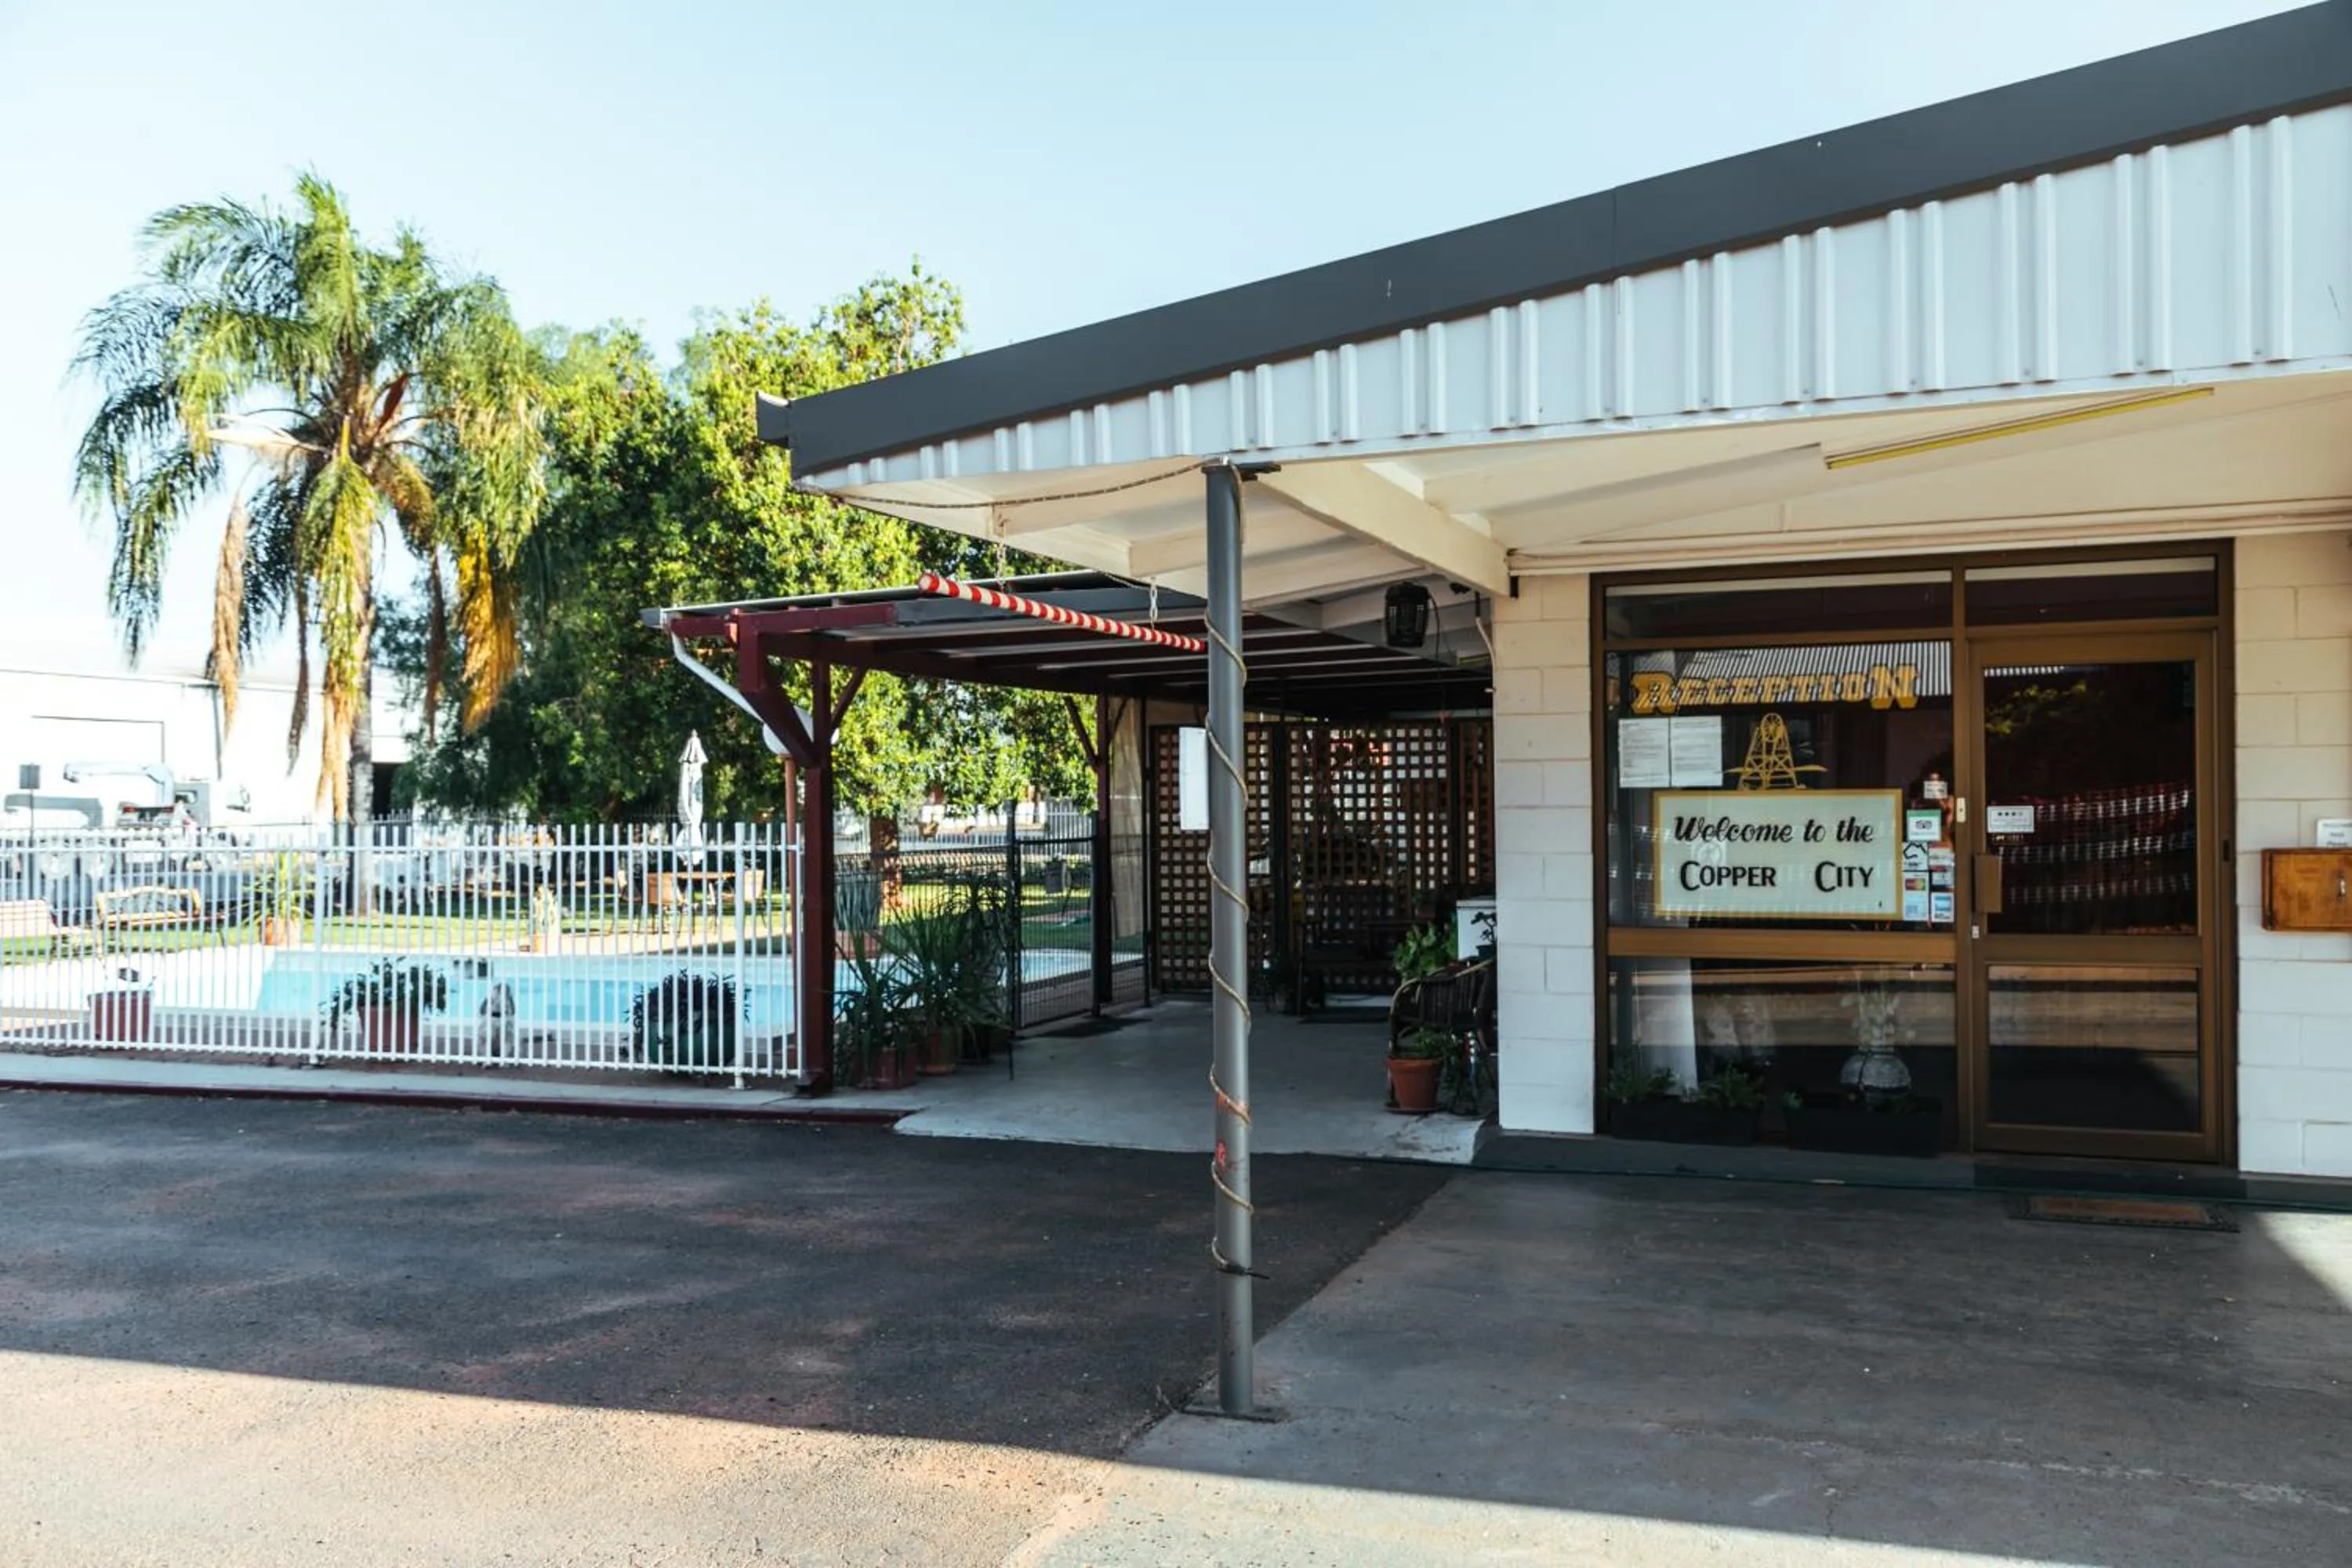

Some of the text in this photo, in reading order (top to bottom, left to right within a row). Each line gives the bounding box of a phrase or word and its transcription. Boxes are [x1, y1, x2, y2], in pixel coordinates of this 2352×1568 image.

[1631, 663, 1918, 715] RECEPTION
[1674, 815, 1874, 843] Welcome to the
[1679, 860, 1875, 893] COPPER CITY
